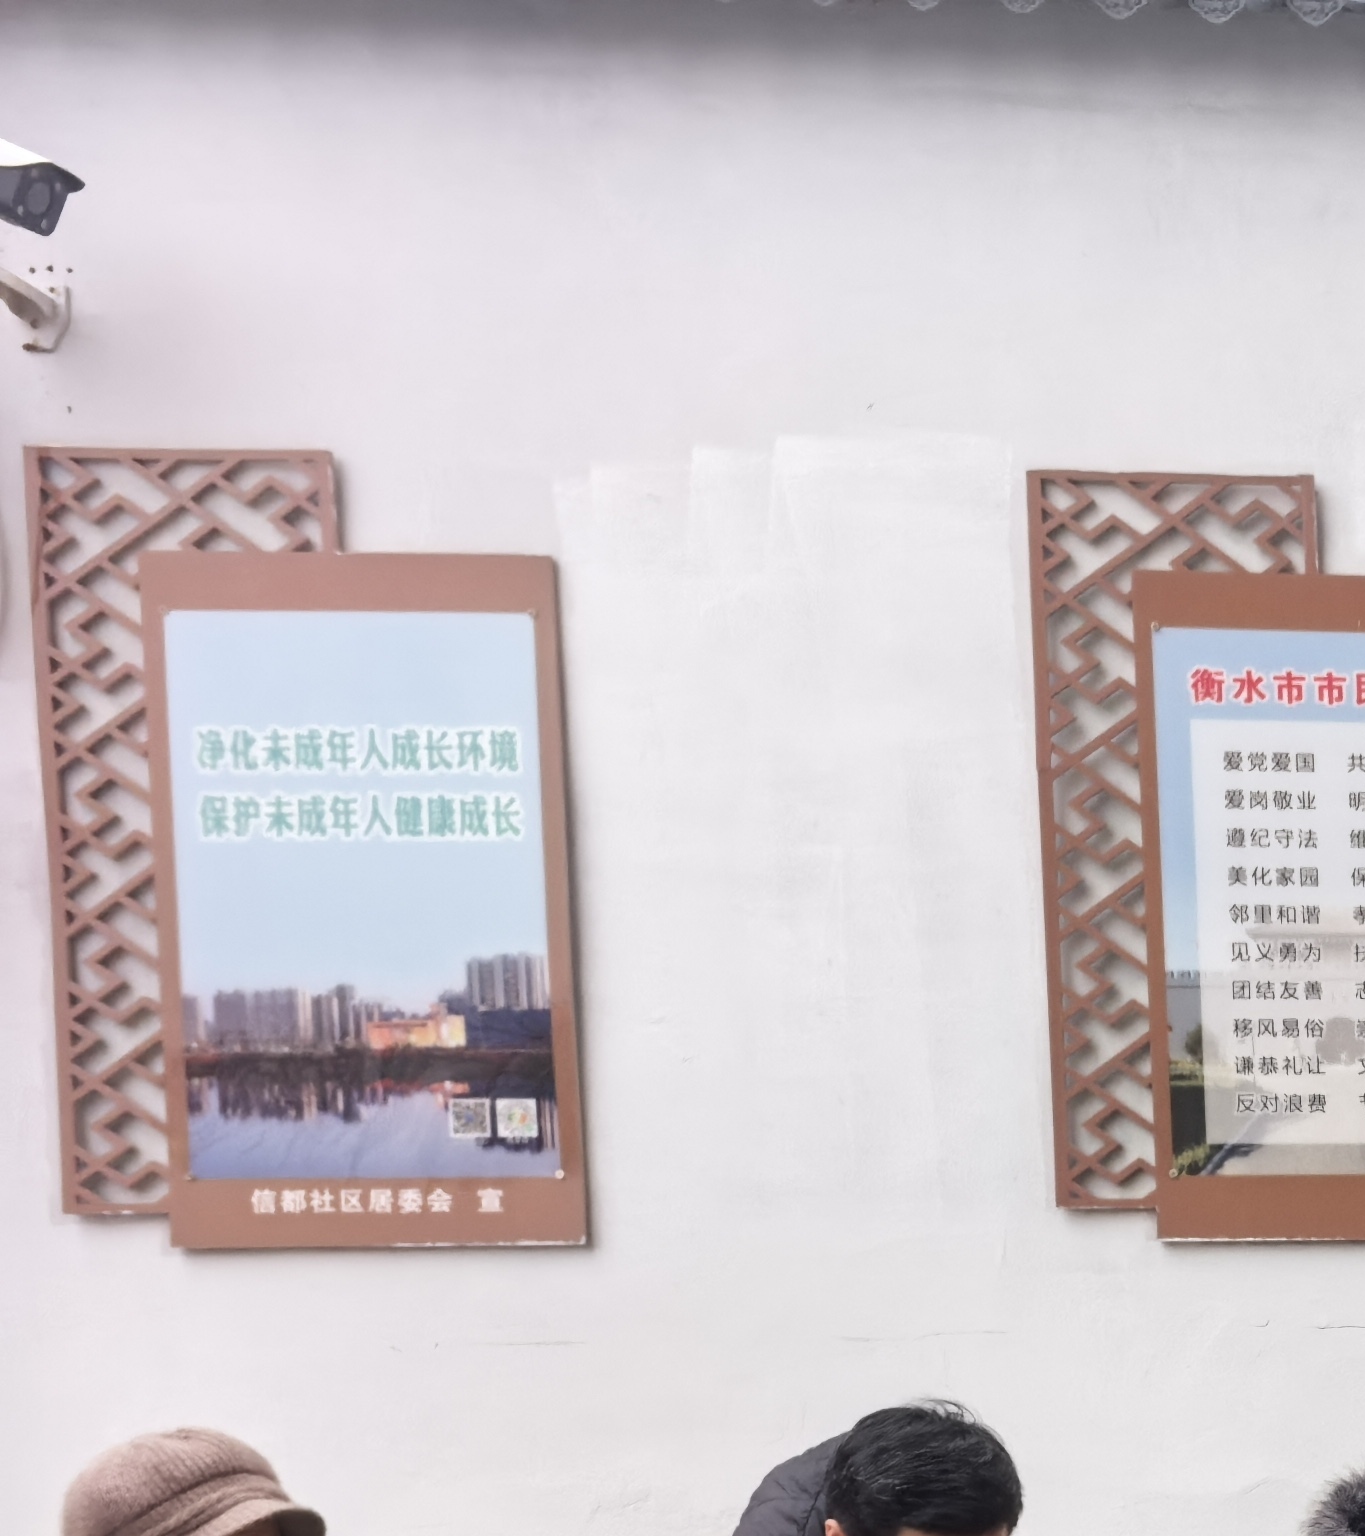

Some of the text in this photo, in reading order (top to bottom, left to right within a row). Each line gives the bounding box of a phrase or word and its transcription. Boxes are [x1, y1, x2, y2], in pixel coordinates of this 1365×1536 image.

[196, 727, 519, 772] 净化未成年人成长环境
[1223, 751, 1316, 773] 爱党爱国
[1224, 789, 1317, 811] 爱岗敬业
[199, 793, 521, 837] 保护未成年人健康成长
[1226, 827, 1318, 849] 遵纪守法
[1227, 866, 1319, 888] 美化家园
[1229, 903, 1321, 925] 邻里和谐
[1231, 941, 1321, 963] 见义勇为
[1232, 980, 1323, 1001] 团结友善
[1233, 1017, 1325, 1039] 移风易俗
[1234, 1055, 1327, 1076] 谦恭礼让
[1236, 1093, 1327, 1114] 反对浪费
[250, 1187, 453, 1215] 信都社区居委会
